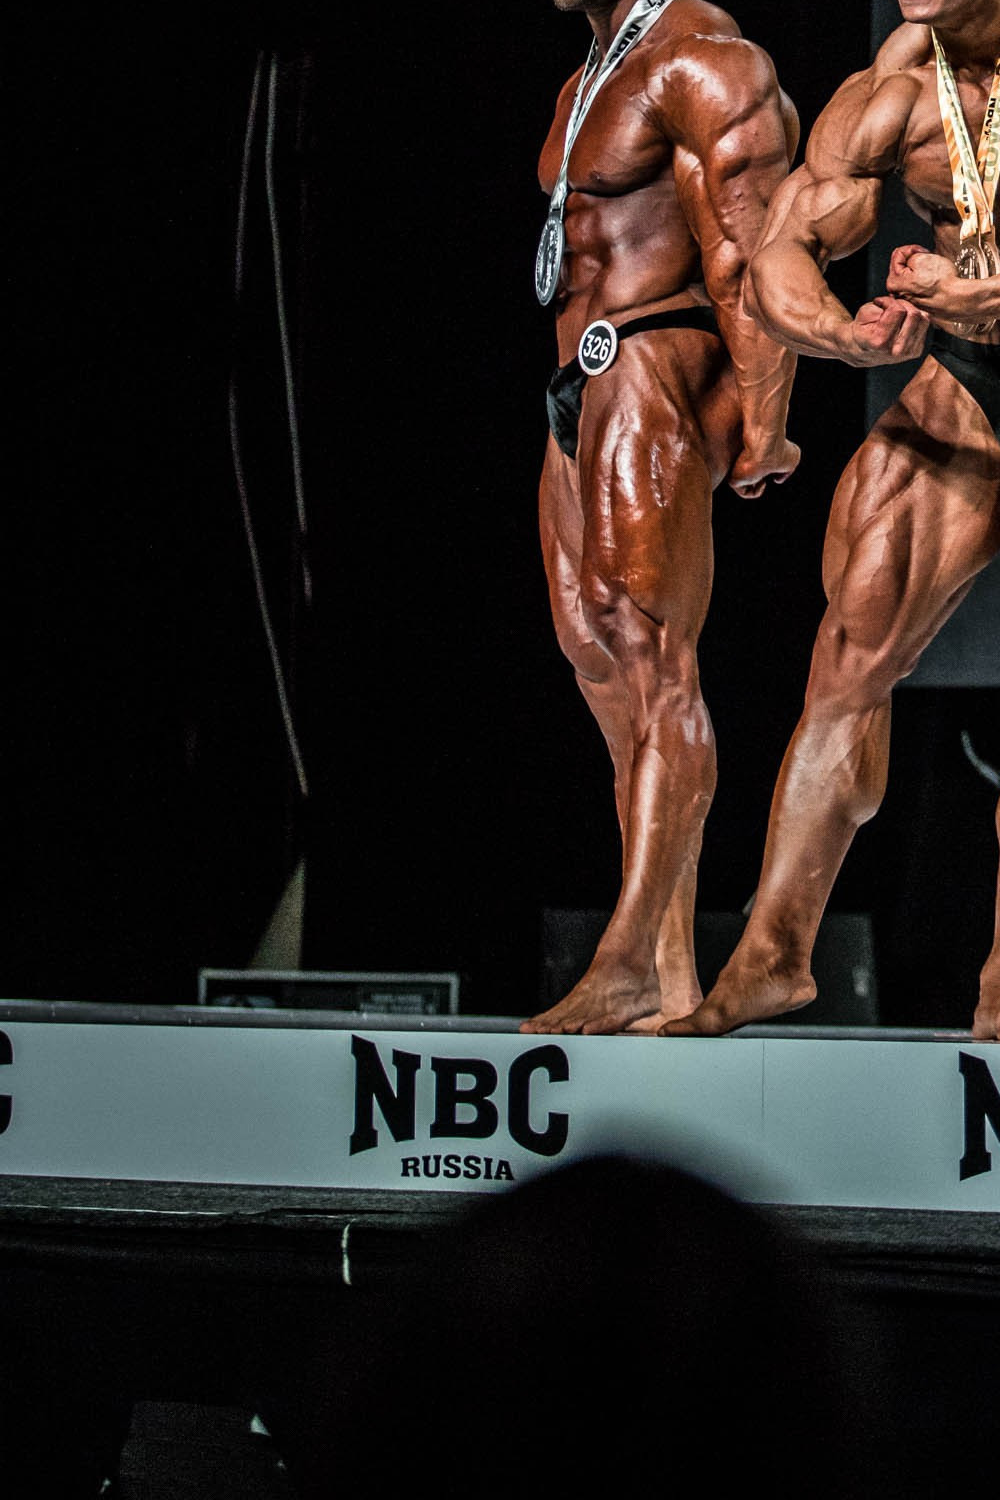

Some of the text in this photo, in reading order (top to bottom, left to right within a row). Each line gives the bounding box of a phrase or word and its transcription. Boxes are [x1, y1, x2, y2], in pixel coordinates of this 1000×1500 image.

[583, 333, 611, 362] 326
[350, 1034, 570, 1157] NBC
[401, 1154, 515, 1181] RUSSIA
